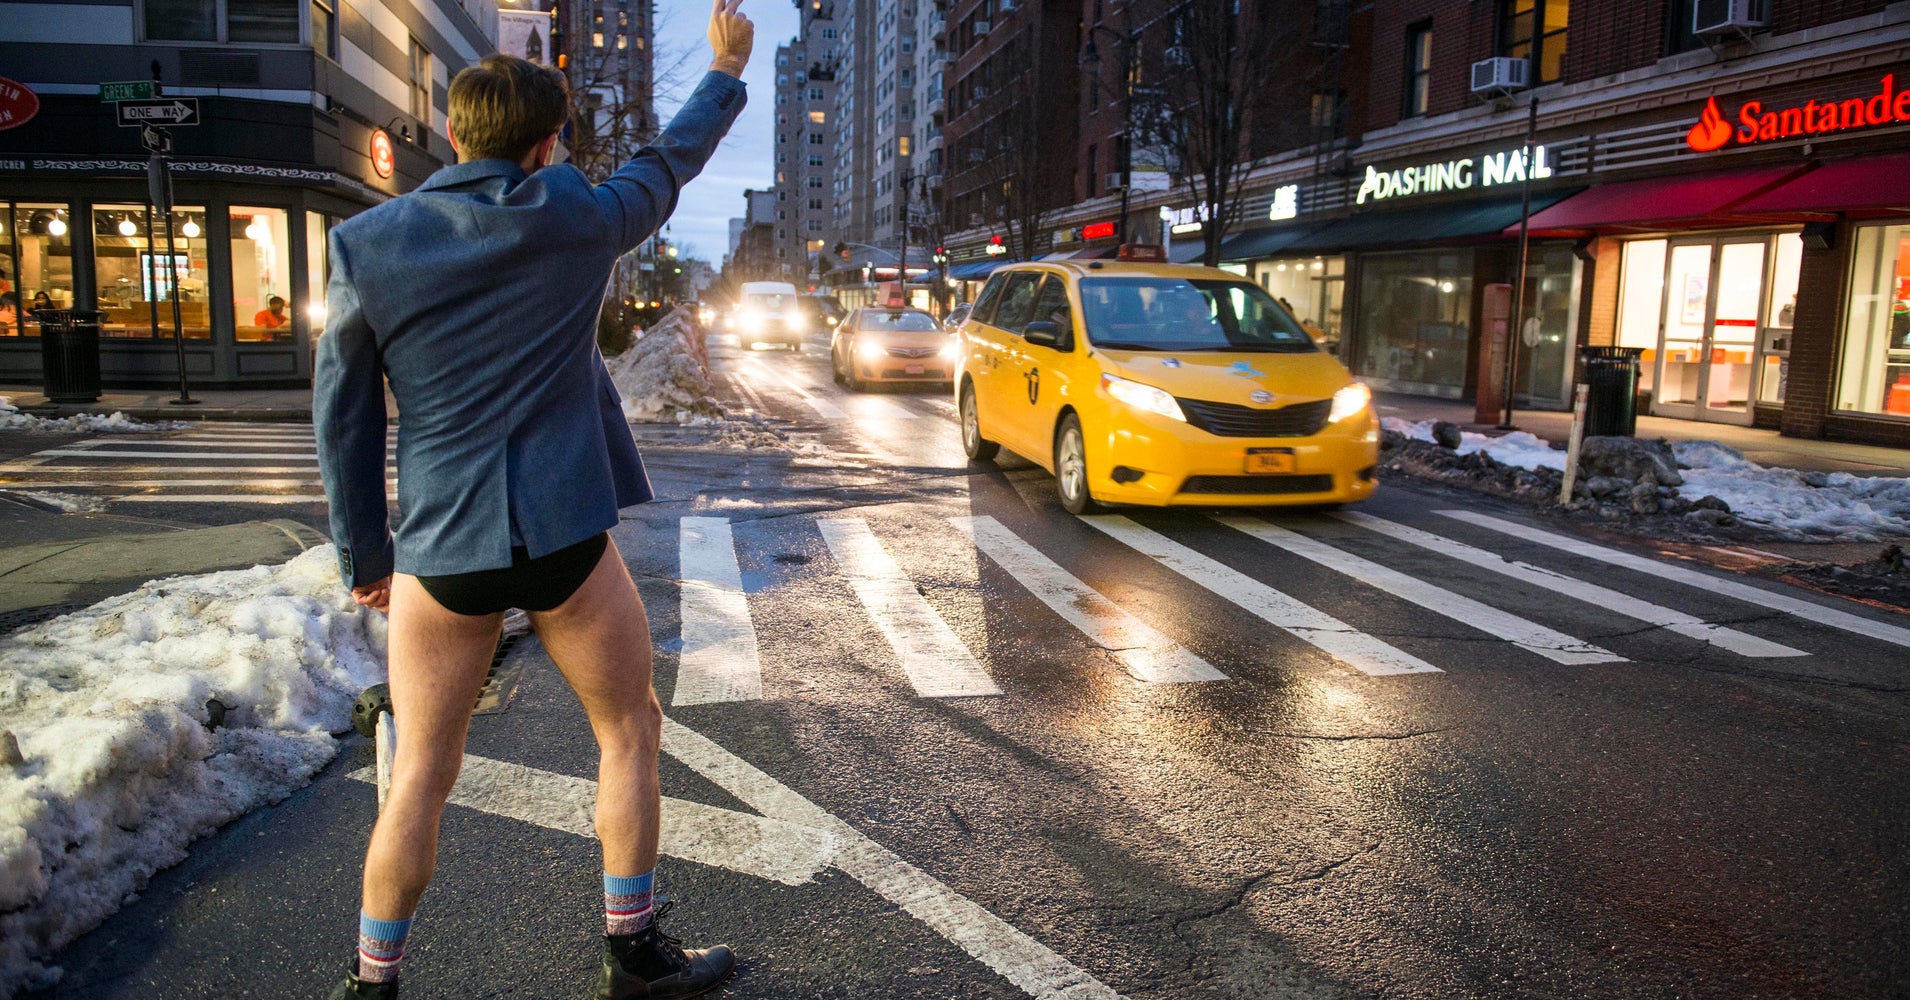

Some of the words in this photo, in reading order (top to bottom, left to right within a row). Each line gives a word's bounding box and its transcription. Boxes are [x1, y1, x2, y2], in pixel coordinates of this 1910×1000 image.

[103, 84, 135, 99] GREENE
[138, 83, 148, 92] ST
[129, 107, 153, 118] ONE
[162, 107, 186, 118] WAY
[1373, 158, 1473, 199] DASHING
